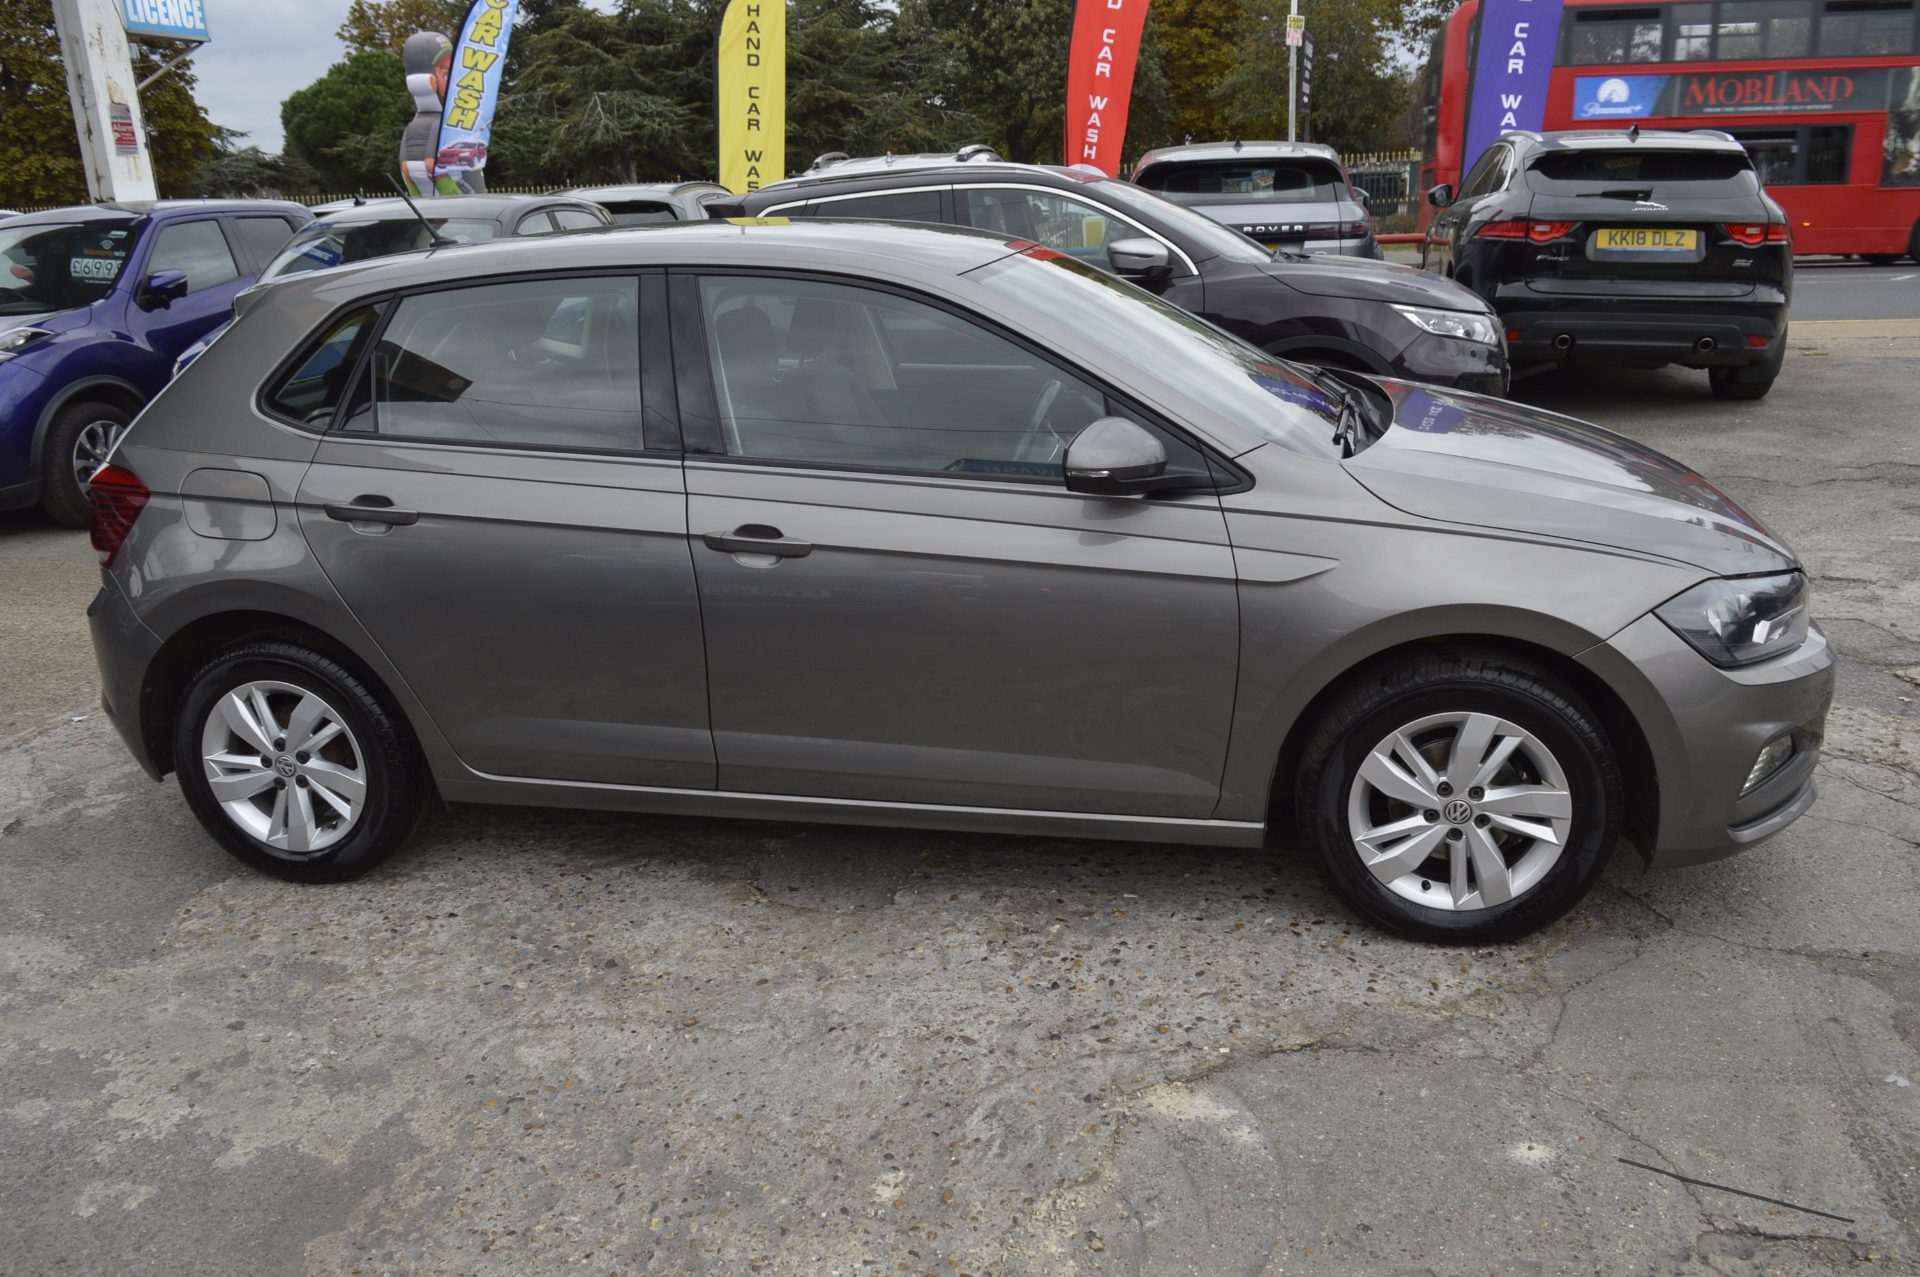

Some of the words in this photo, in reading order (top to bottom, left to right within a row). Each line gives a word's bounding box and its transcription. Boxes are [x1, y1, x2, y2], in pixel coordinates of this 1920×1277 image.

[125, 0, 205, 30] LICENCE
[746, 4, 760, 67] HAND
[1095, 28, 1117, 78] CAR
[1507, 22, 1530, 75] CAR
[447, 46, 499, 131] WASH
[747, 86, 761, 131] CAR
[1083, 94, 1109, 160] WASH
[744, 150, 763, 193] WAS
[1243, 225, 1304, 233] ROVER
[1607, 230, 1646, 247] KK18
[1651, 231, 1686, 247] DLZ
